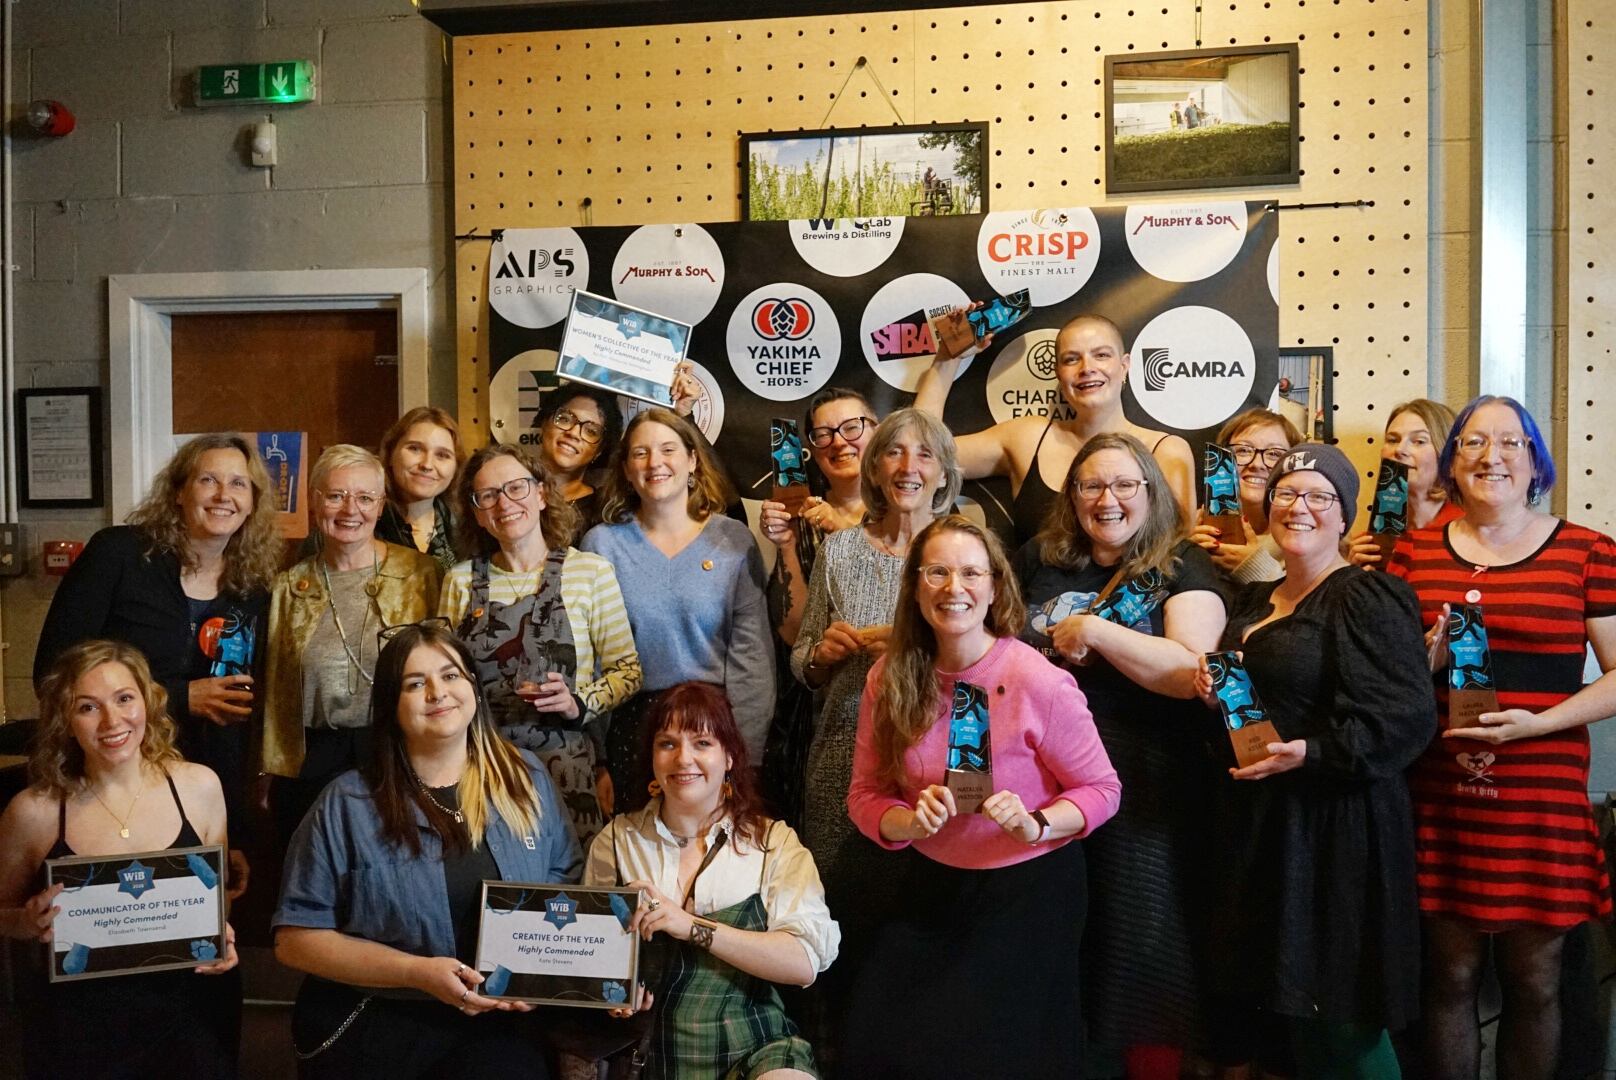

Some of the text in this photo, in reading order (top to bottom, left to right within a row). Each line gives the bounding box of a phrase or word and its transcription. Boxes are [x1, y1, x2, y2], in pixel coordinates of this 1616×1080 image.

[1133, 214, 1240, 235] MURPHY & SON
[802, 231, 840, 240] Brewing
[851, 230, 892, 239] Distilling
[987, 231, 1089, 262] CRISP
[495, 249, 574, 278] APS
[619, 265, 716, 284] MURPHY & SON
[1000, 267, 1076, 277] FINEST MALT
[494, 284, 574, 295] GRAPHICS
[928, 303, 952, 319] SOCIETY
[572, 327, 602, 340] WOMEN'S
[603, 336, 640, 352] COLLECTIVE
[640, 347, 650, 355] OF
[651, 350, 663, 359] THE
[663, 355, 679, 363] YEAR
[872, 322, 937, 355] SIBA
[747, 345, 821, 359] YAKIMA
[756, 361, 813, 375] CHIEF
[1157, 361, 1245, 378] CAMRA
[1002, 389, 1069, 405] CHARL
[519, 433, 543, 445] ek
[123, 871, 145, 882] WiB
[68, 897, 205, 918] COMMUNICATOR OF THE YEAR
[550, 902, 570, 912] WiB
[93, 912, 178, 928] Highly Commended
[512, 932, 605, 944] CREATIVE OF THE YEAR
[518, 945, 595, 956] Highly Commended
